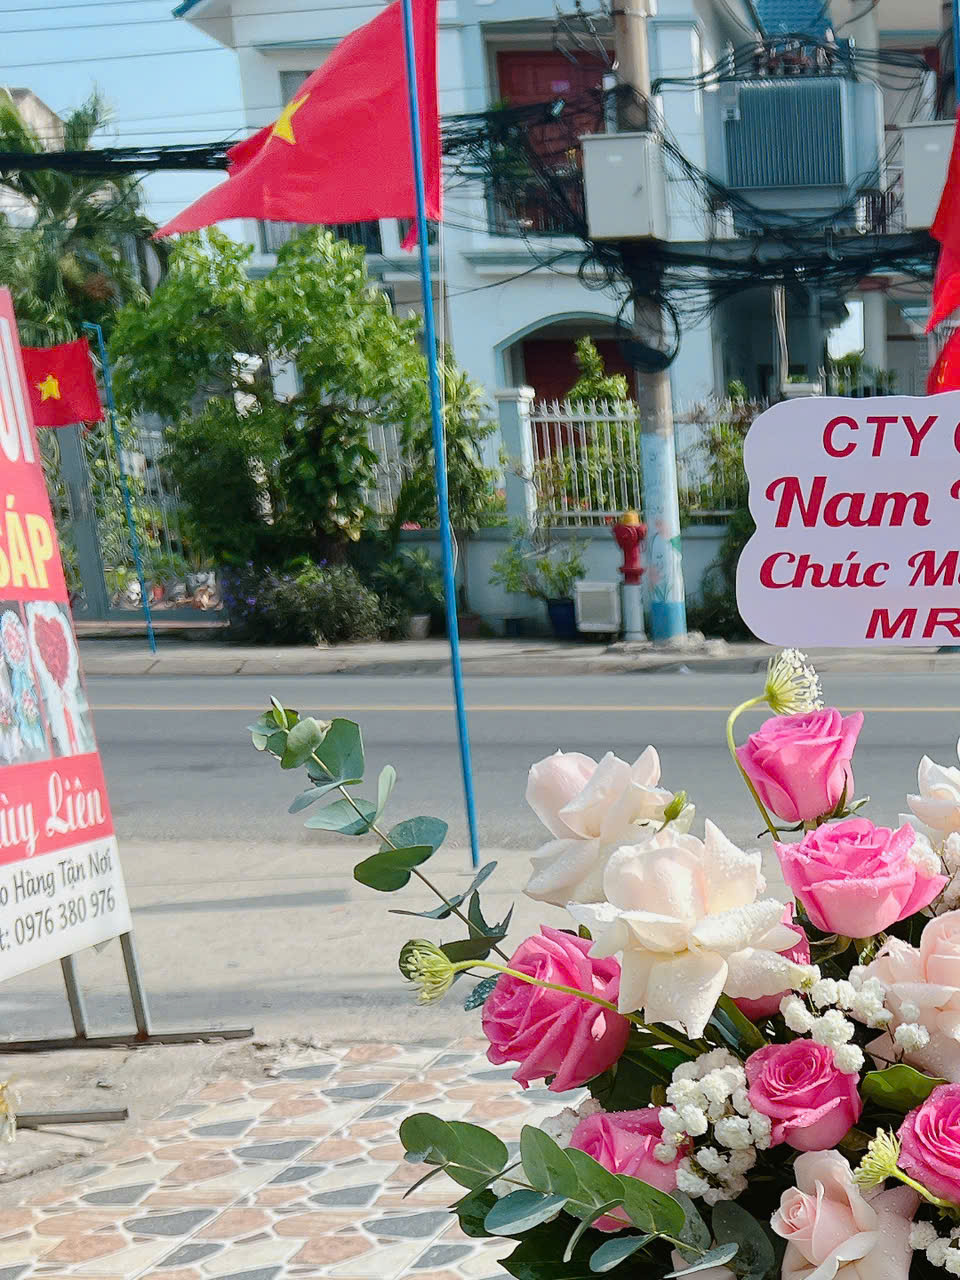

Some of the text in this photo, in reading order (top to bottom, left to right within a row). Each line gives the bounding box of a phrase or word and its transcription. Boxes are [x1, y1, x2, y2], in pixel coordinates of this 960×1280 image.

[823, 415, 937, 458] CTY
[765, 475, 931, 529] Nam
[759, 551, 890, 590] Chúc
[45, 771, 106, 838] Liên
[13, 868, 56, 904] Hàng
[15, 906, 55, 946] 0976
[58, 895, 87, 932] 380
[90, 886, 116, 920] 976
